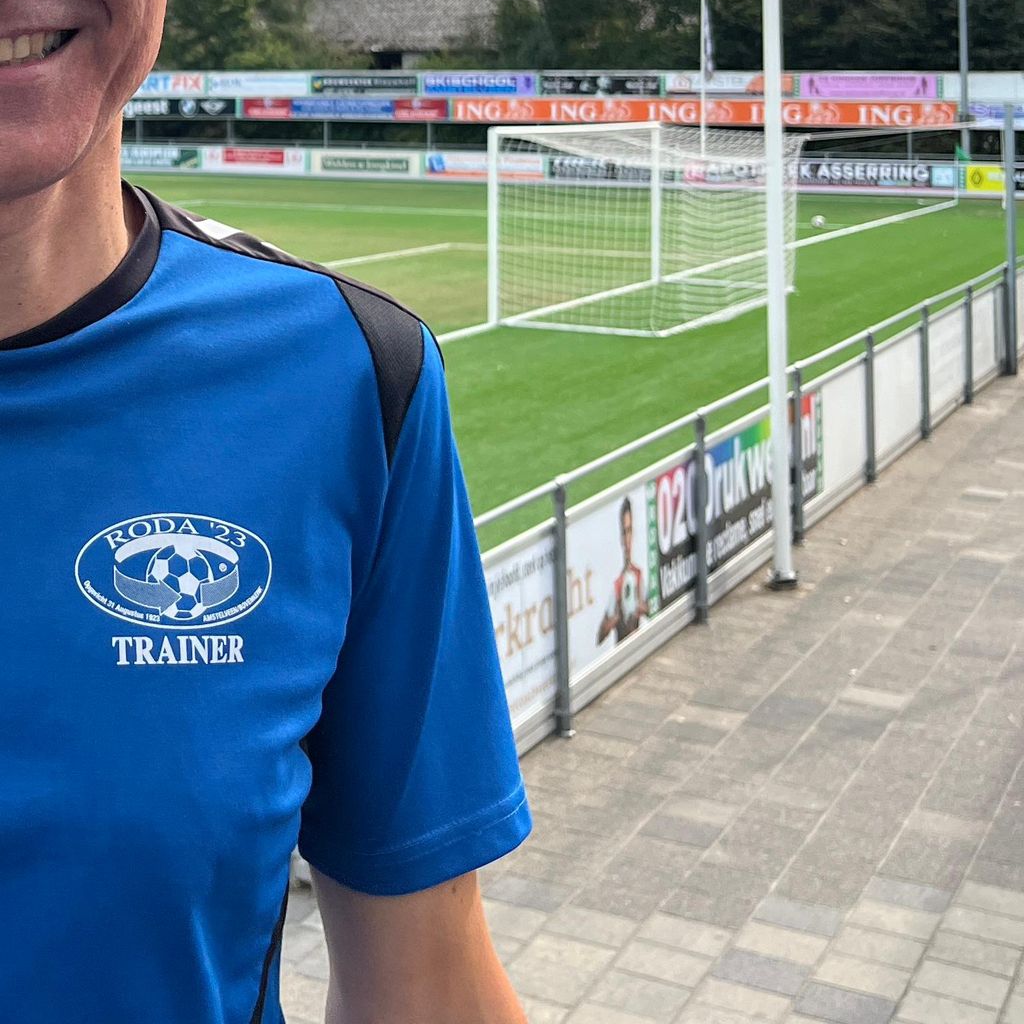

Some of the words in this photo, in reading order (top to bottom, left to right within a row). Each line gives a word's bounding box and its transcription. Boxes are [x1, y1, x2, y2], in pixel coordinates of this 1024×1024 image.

[455, 100, 501, 122] ING
[549, 100, 599, 123] ING
[647, 102, 696, 123] ING
[750, 103, 802, 124] IG
[858, 104, 914, 126] ING
[817, 163, 931, 182] ASSERRING
[104, 517, 200, 550] RODA
[210, 521, 247, 548] '23
[111, 634, 245, 666] TRAINER
